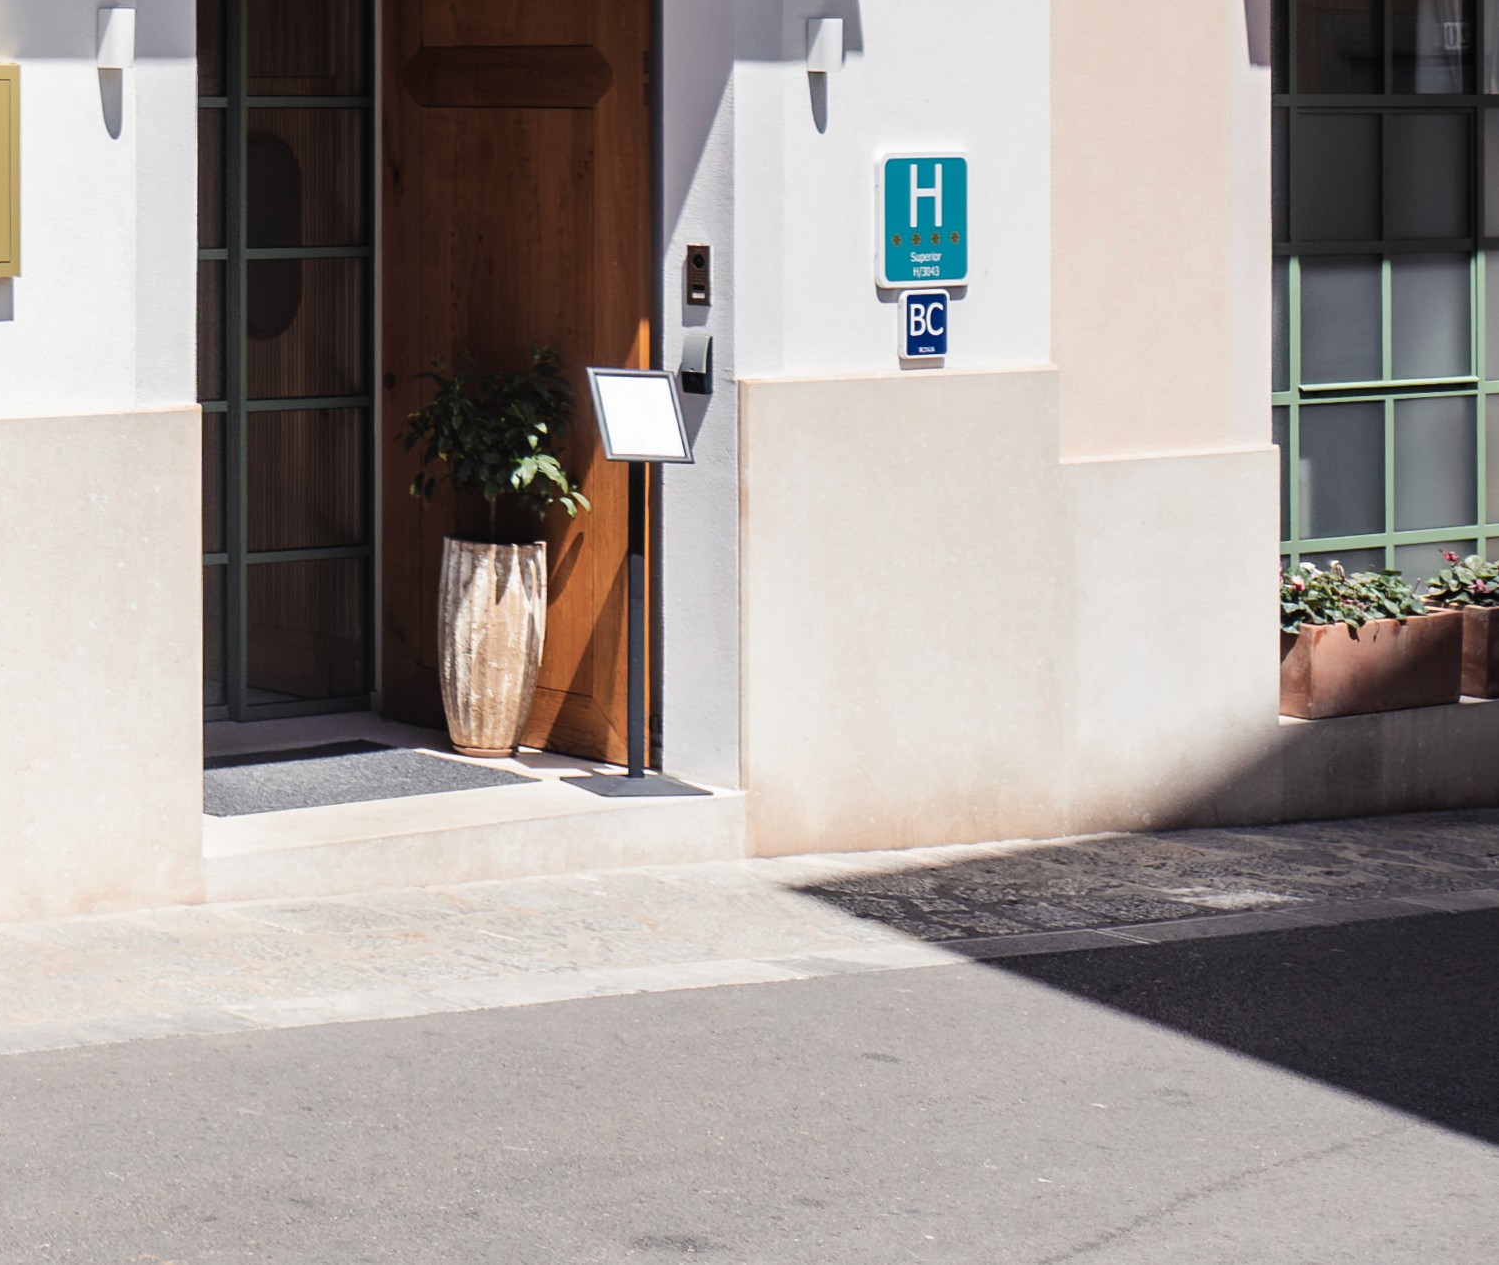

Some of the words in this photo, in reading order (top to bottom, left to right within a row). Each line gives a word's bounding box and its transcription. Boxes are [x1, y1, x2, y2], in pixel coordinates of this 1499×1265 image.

[909, 163, 943, 228] H
[909, 251, 942, 264] Superior
[909, 301, 944, 337] BC
